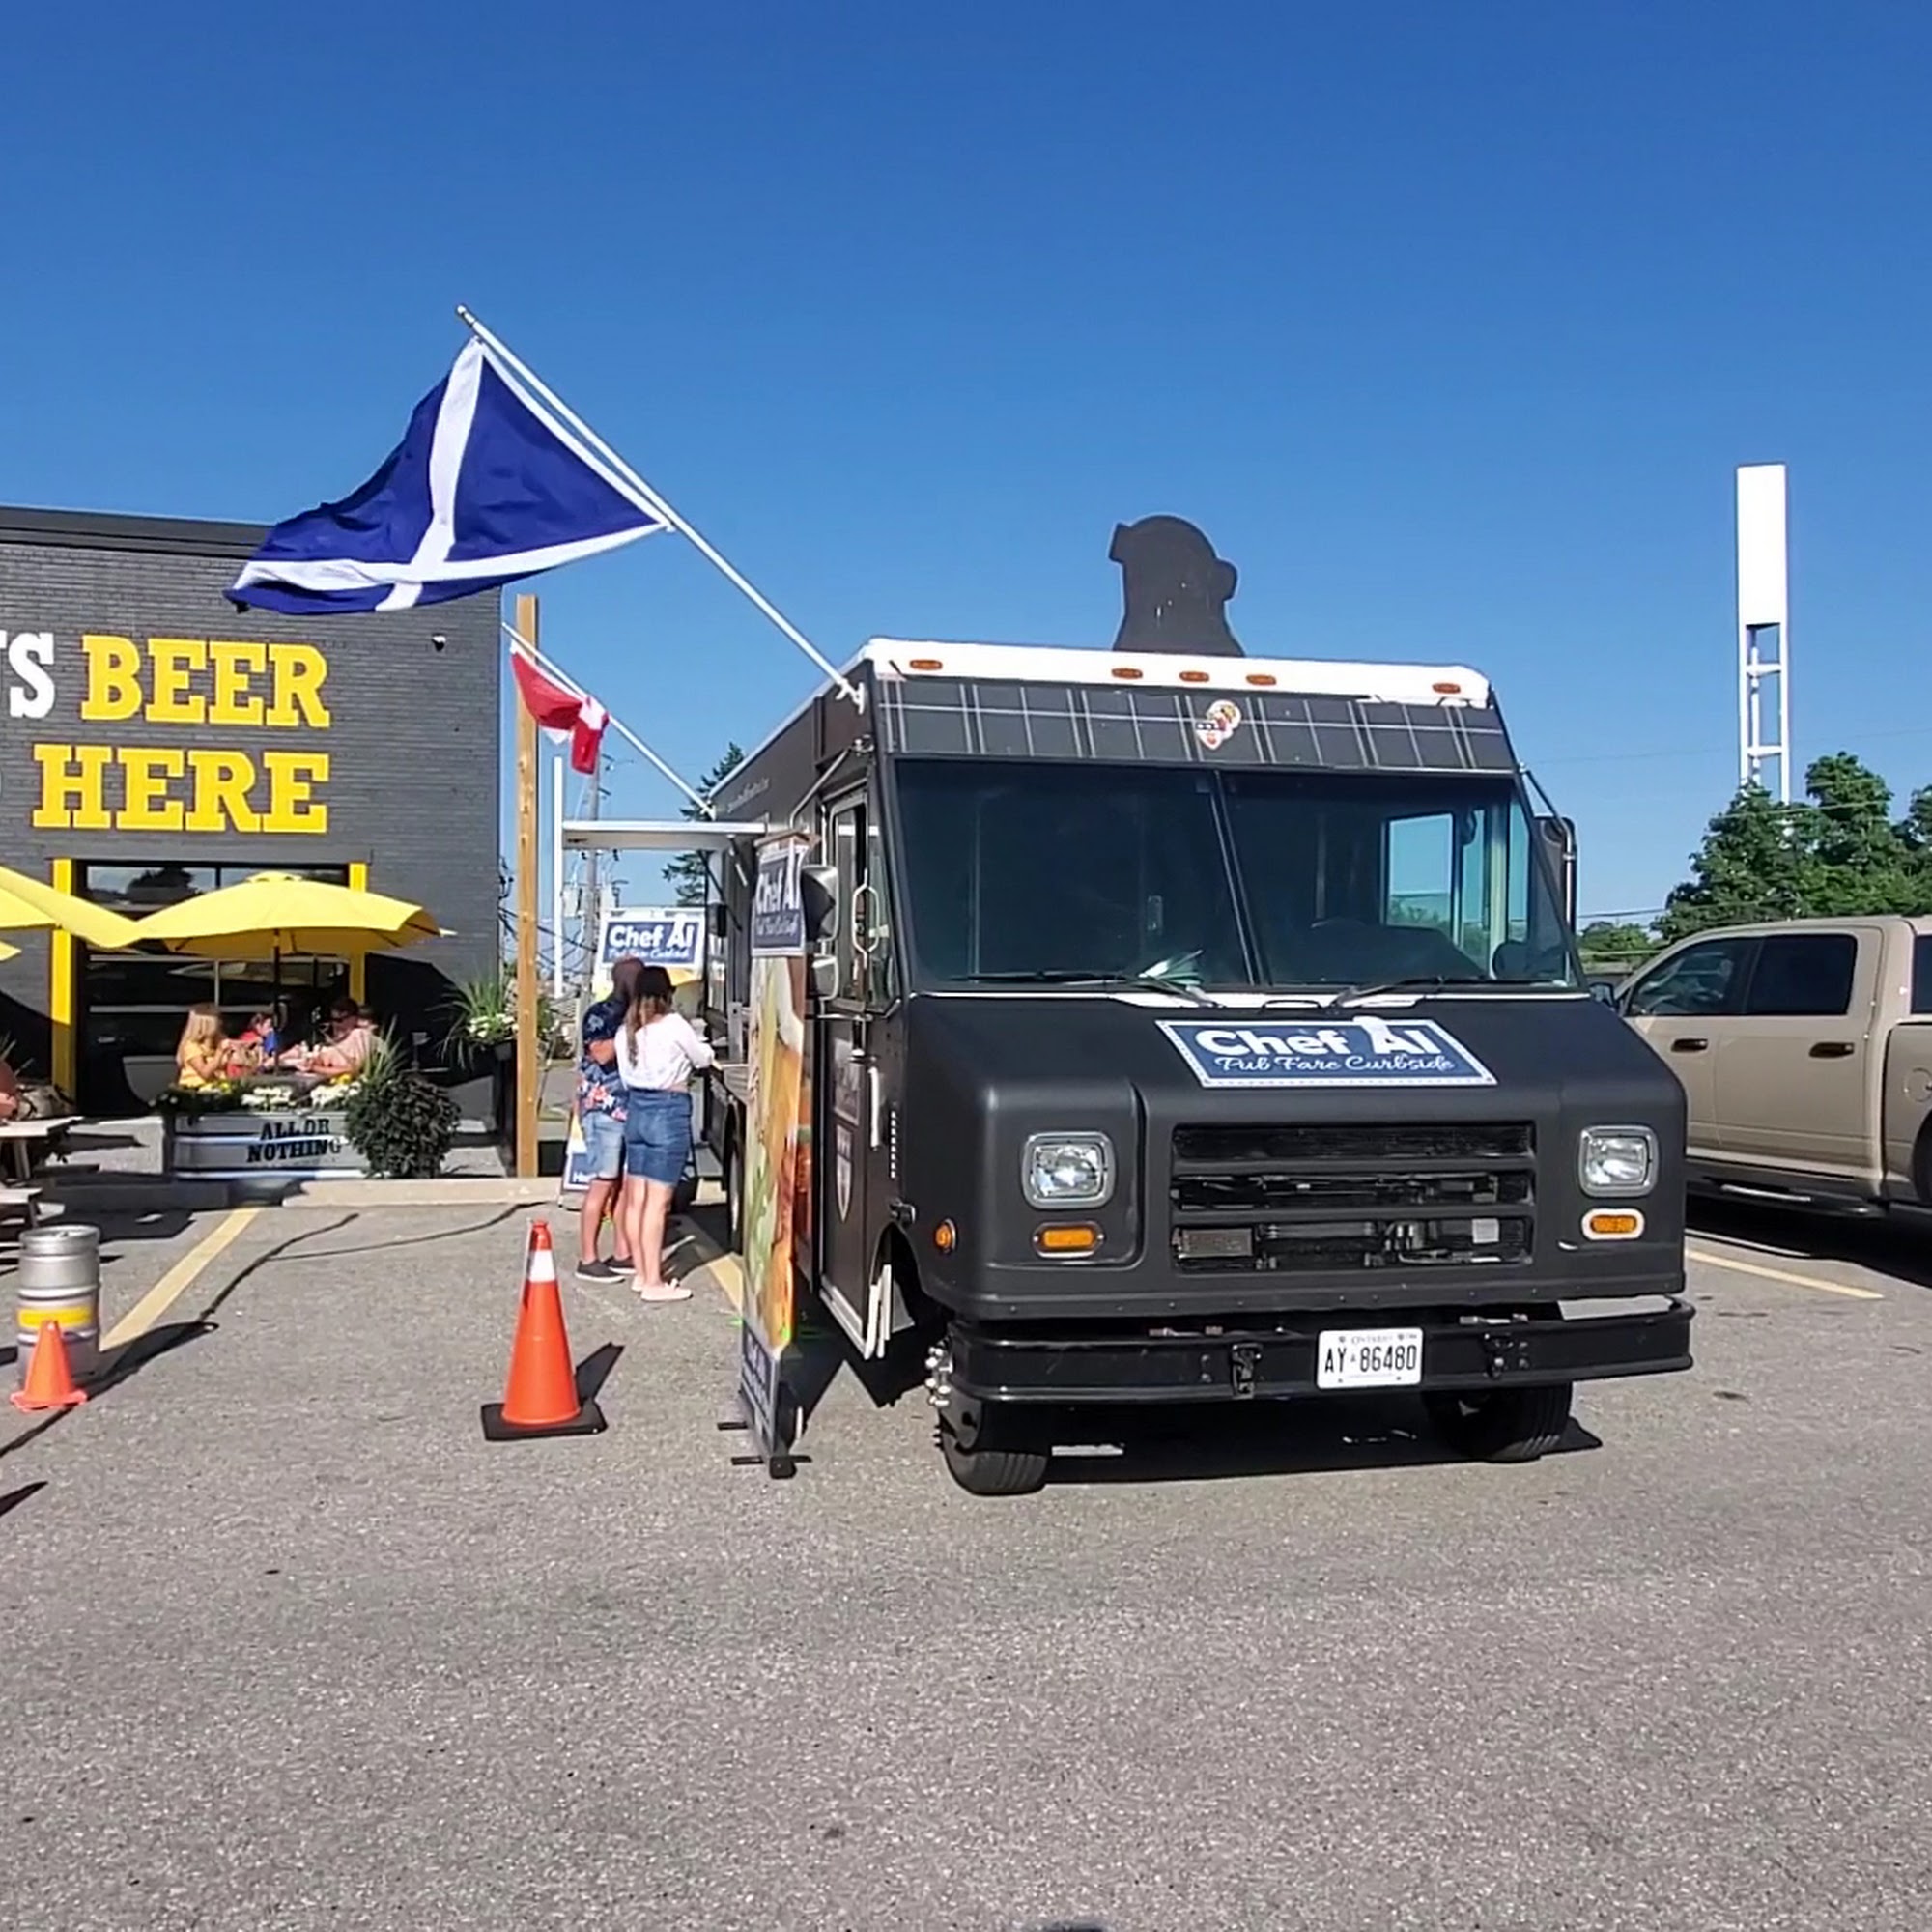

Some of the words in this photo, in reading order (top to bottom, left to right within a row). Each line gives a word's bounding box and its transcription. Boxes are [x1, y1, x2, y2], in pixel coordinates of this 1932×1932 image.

[0, 630, 55, 718] S
[81, 634, 330, 727] BEER
[33, 743, 329, 833] HERE
[609, 924, 665, 948] Chef
[1195, 1029, 1352, 1056] Chef
[1214, 1056, 1270, 1071] Pub
[1273, 1056, 1343, 1071] Fare
[1345, 1053, 1455, 1072] Curbside
[260, 1122, 300, 1141] ALL
[303, 1119, 330, 1135] OR
[246, 1138, 342, 1163] NOTHING
[1324, 1347, 1347, 1373] AY
[1359, 1344, 1417, 1373] 86480
